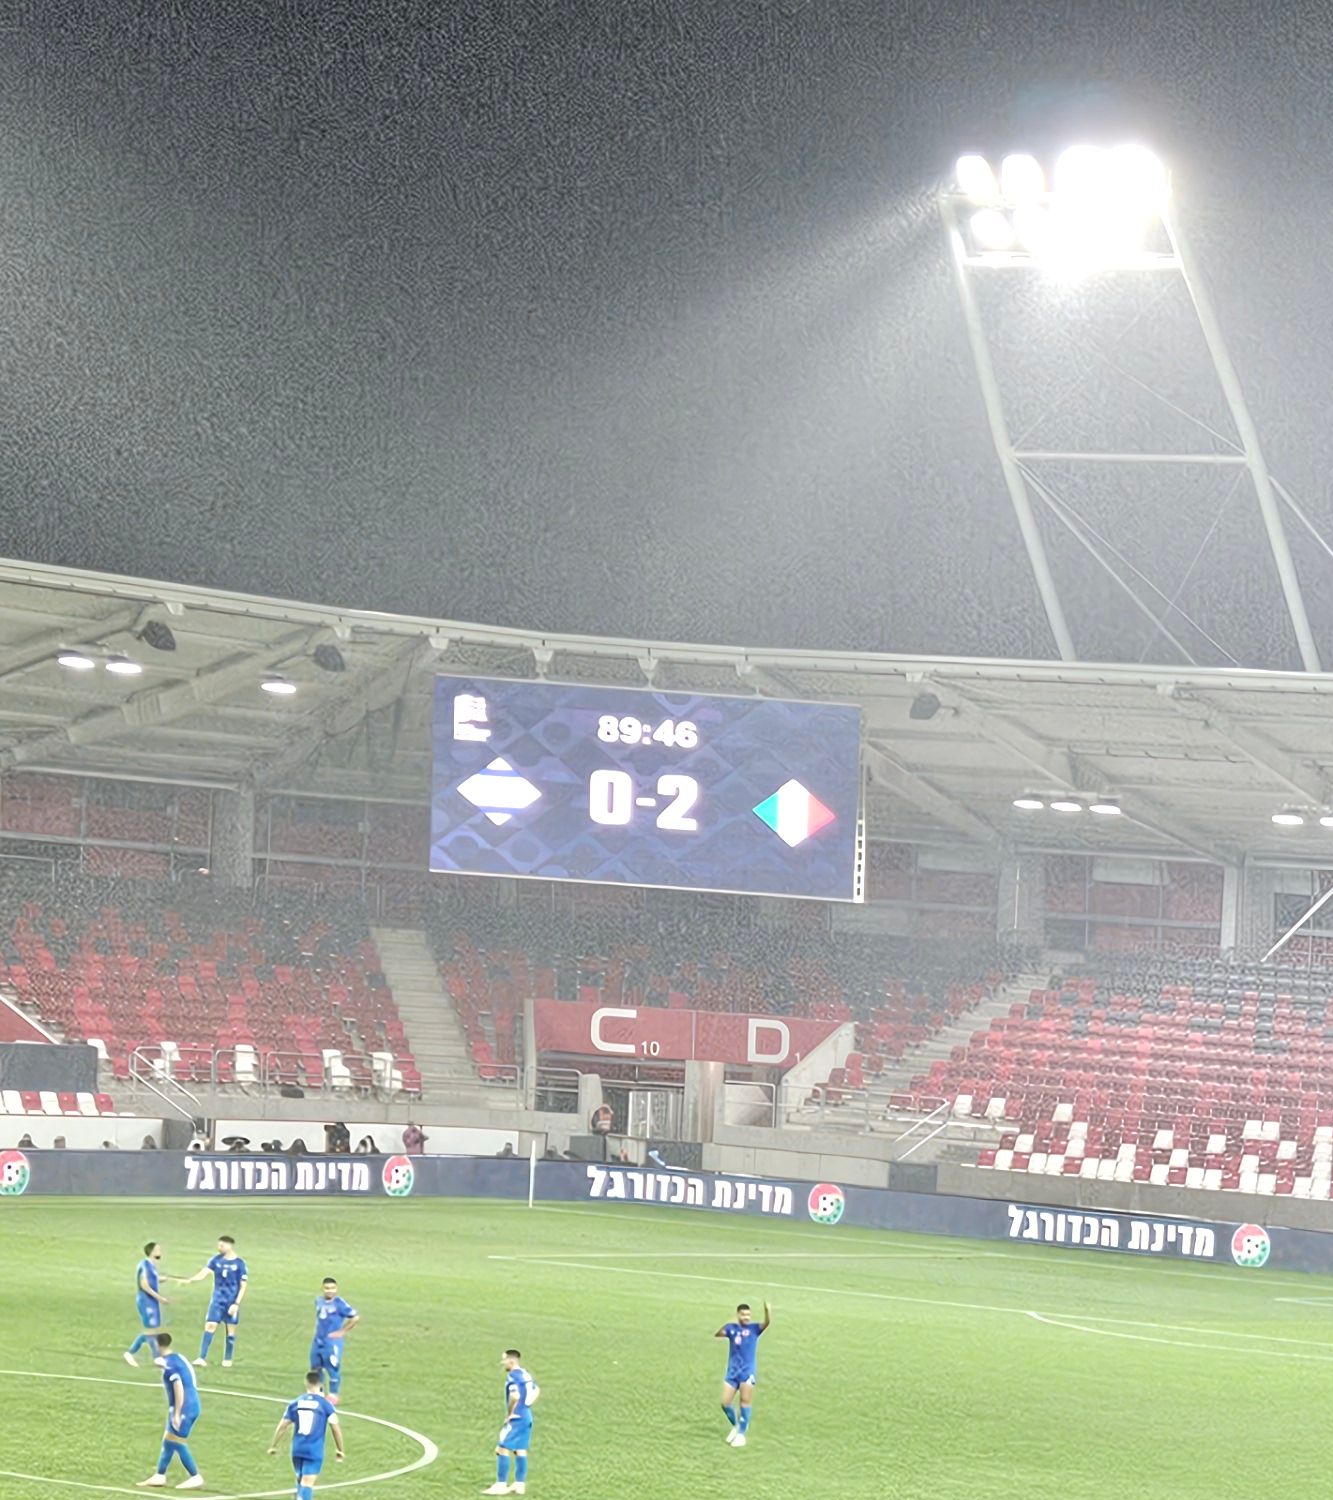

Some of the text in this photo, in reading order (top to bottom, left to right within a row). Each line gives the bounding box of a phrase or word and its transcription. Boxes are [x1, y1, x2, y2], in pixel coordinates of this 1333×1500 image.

[598, 714, 699, 749] 89:46
[588, 769, 699, 831] 0-2
[590, 1007, 661, 1057] C 10
[747, 1018, 790, 1064] D
[184, 1156, 370, 1192] מדינת הכדורגל
[586, 1165, 793, 1216] מדינת הכדורגל
[1008, 1204, 1215, 1258] מדינת הכדורגל
